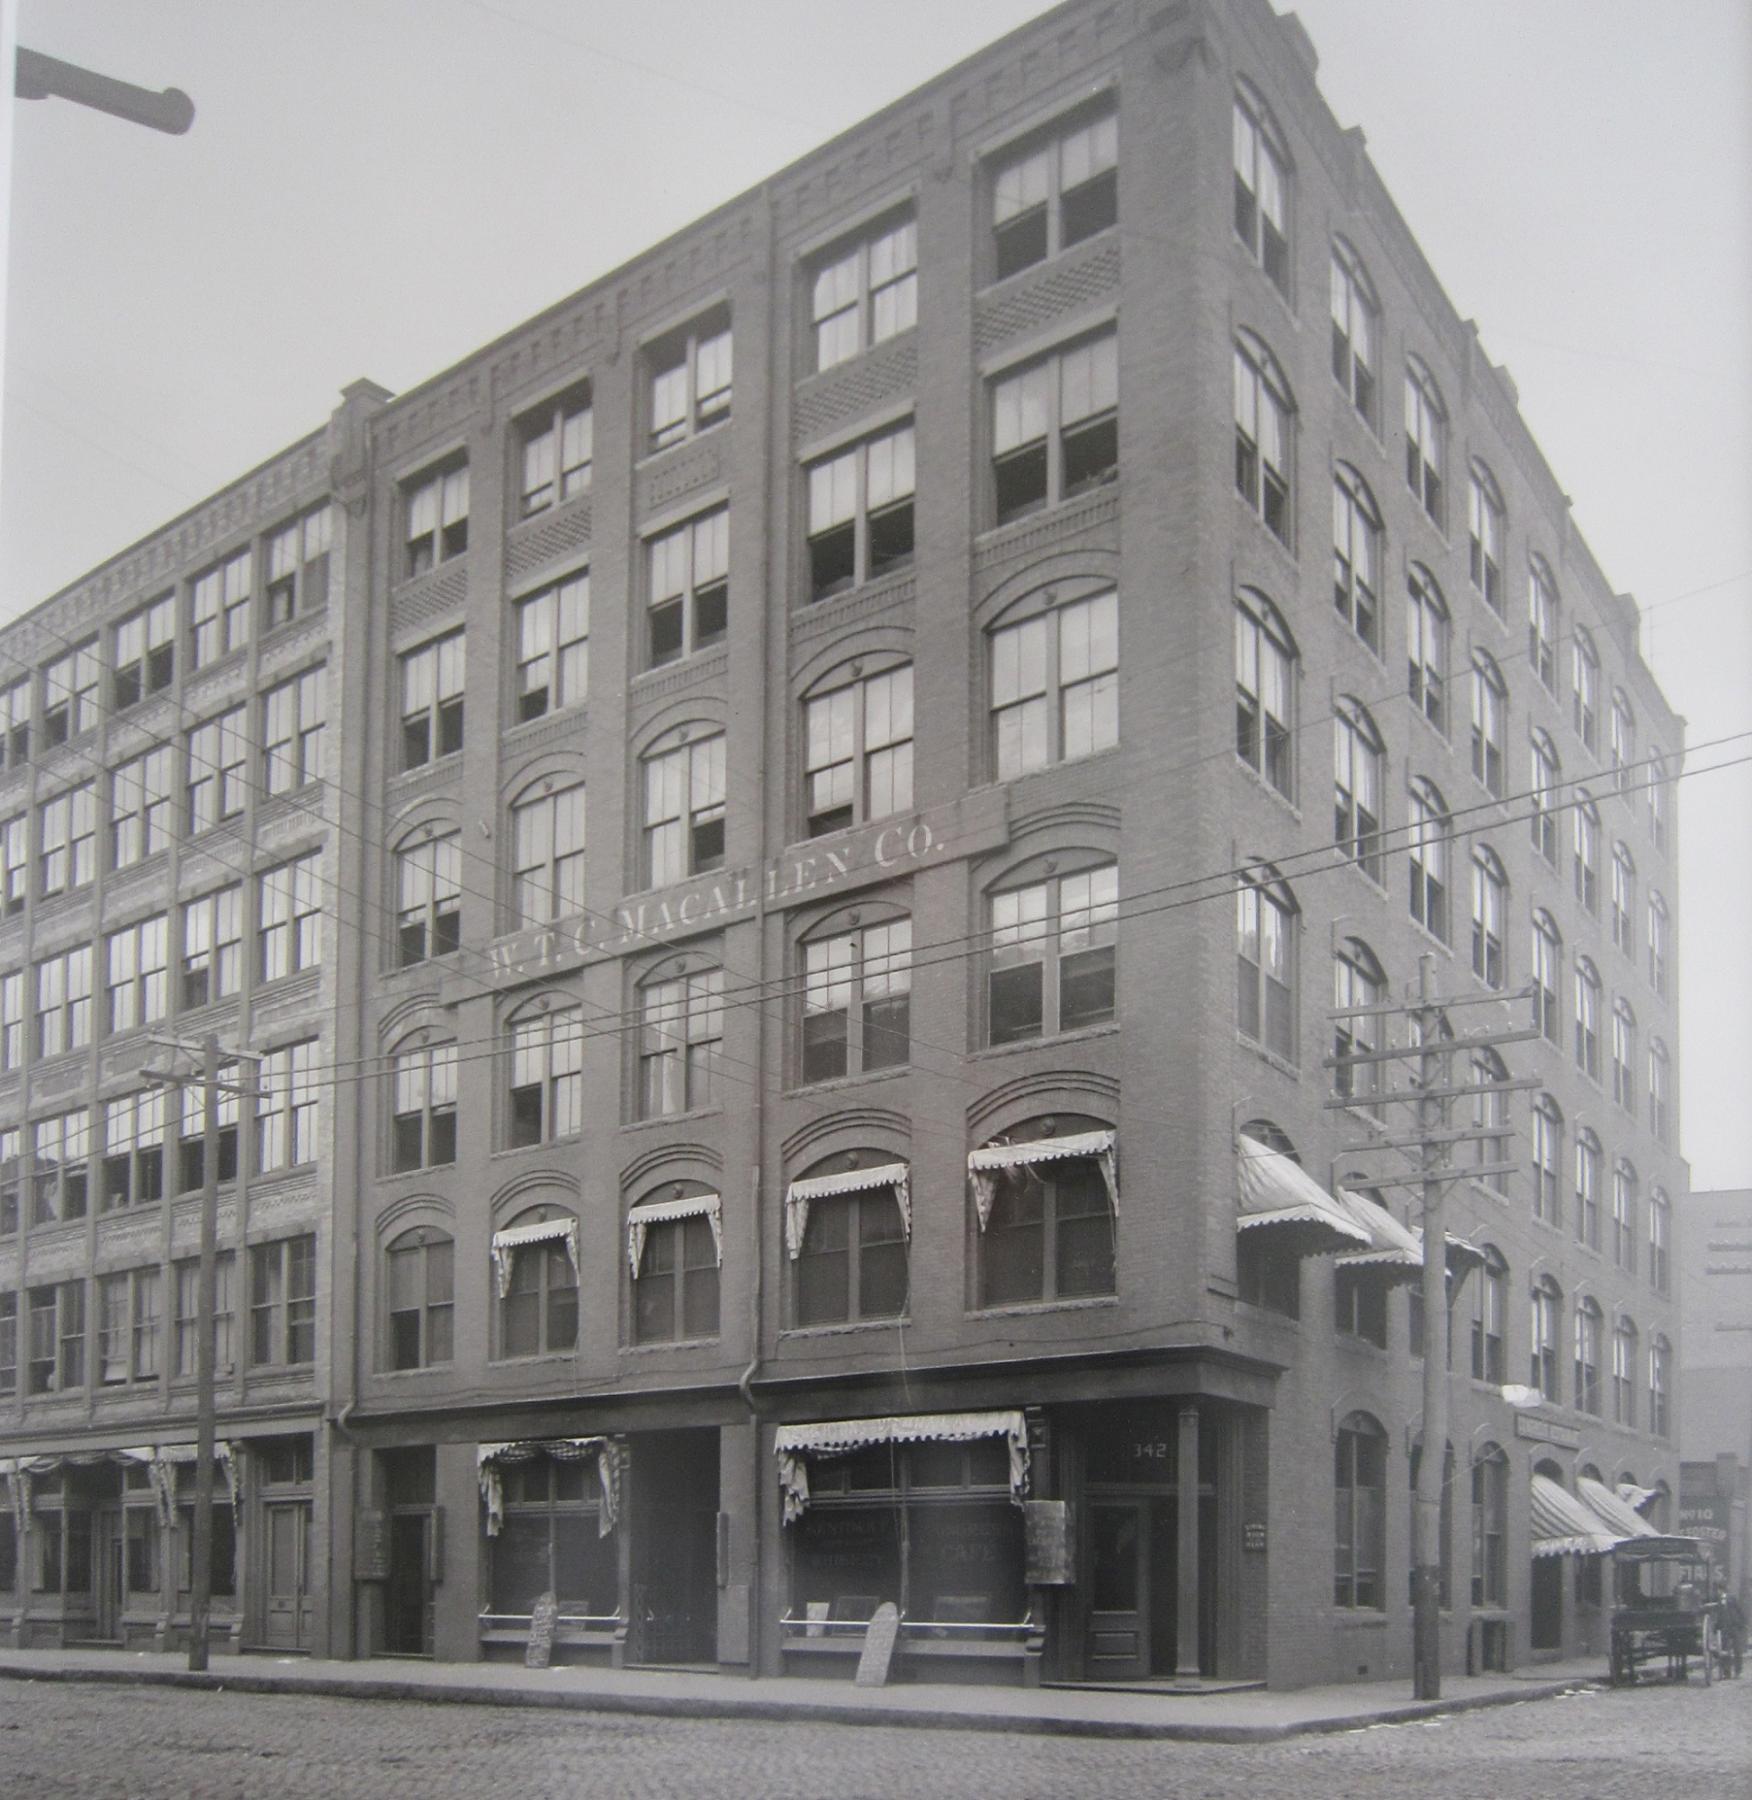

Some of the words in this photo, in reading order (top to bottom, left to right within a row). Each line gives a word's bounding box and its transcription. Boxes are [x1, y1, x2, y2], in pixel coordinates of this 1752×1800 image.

[621, 848, 849, 943] MACALLEN
[875, 824, 944, 867] CO.
[1135, 1443, 1167, 1458] 342
